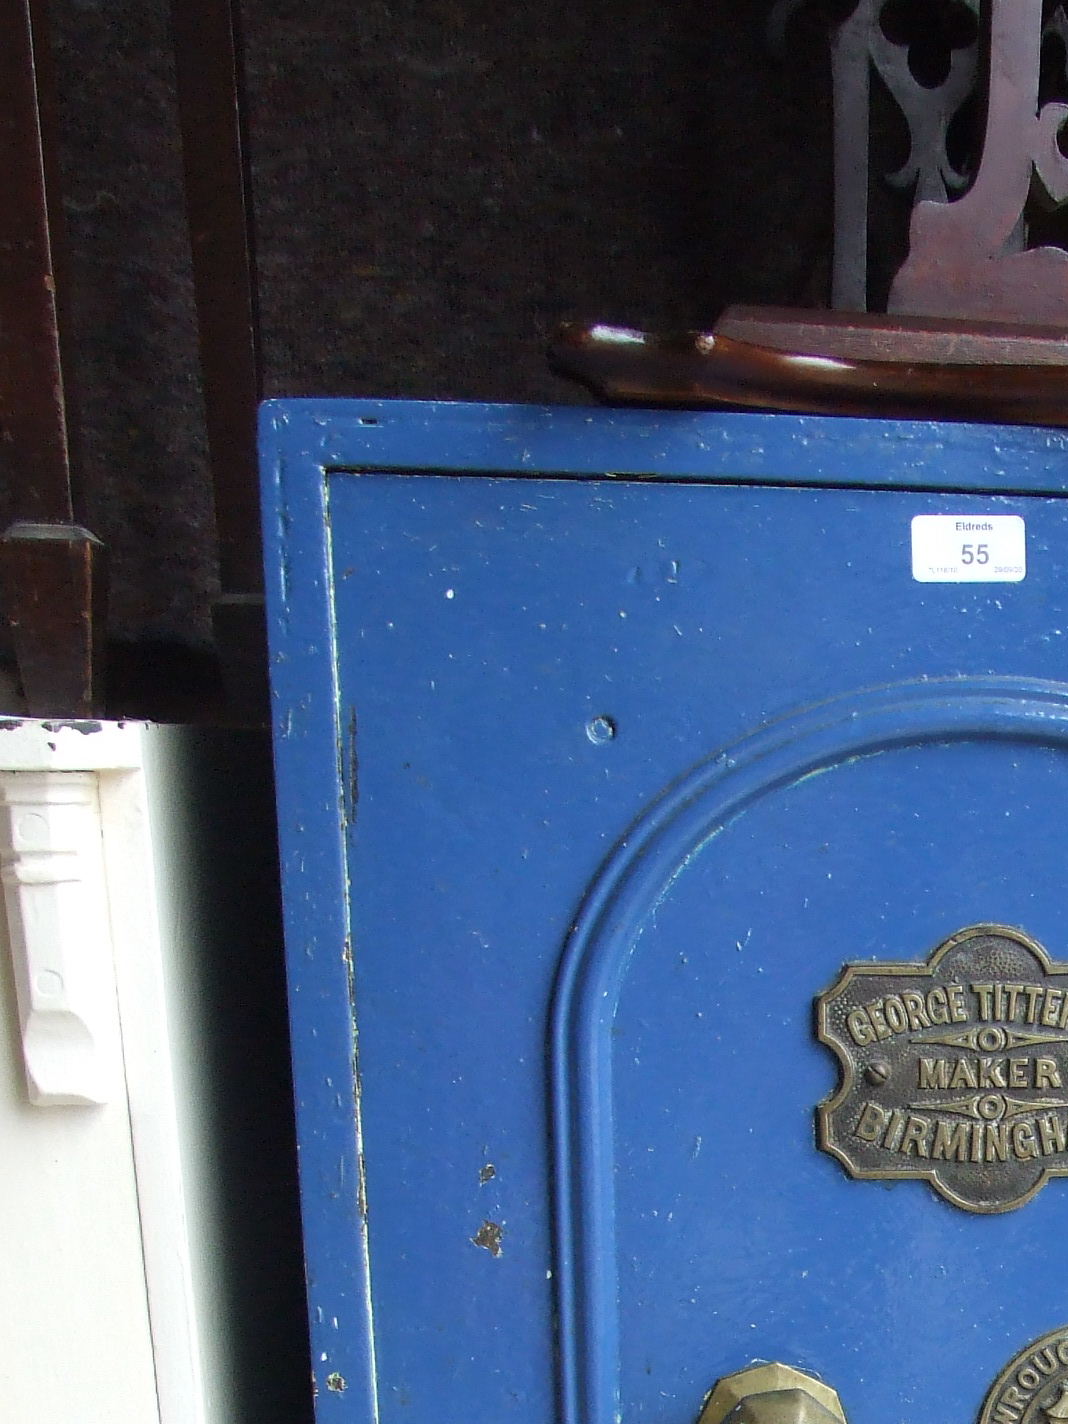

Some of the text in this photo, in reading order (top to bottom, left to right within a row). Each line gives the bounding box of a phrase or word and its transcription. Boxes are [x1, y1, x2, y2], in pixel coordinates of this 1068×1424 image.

[955, 522, 994, 531] Eldreds
[961, 544, 990, 565] 55
[847, 983, 968, 1047] GEORGE
[918, 1057, 1062, 1089] MAKER
